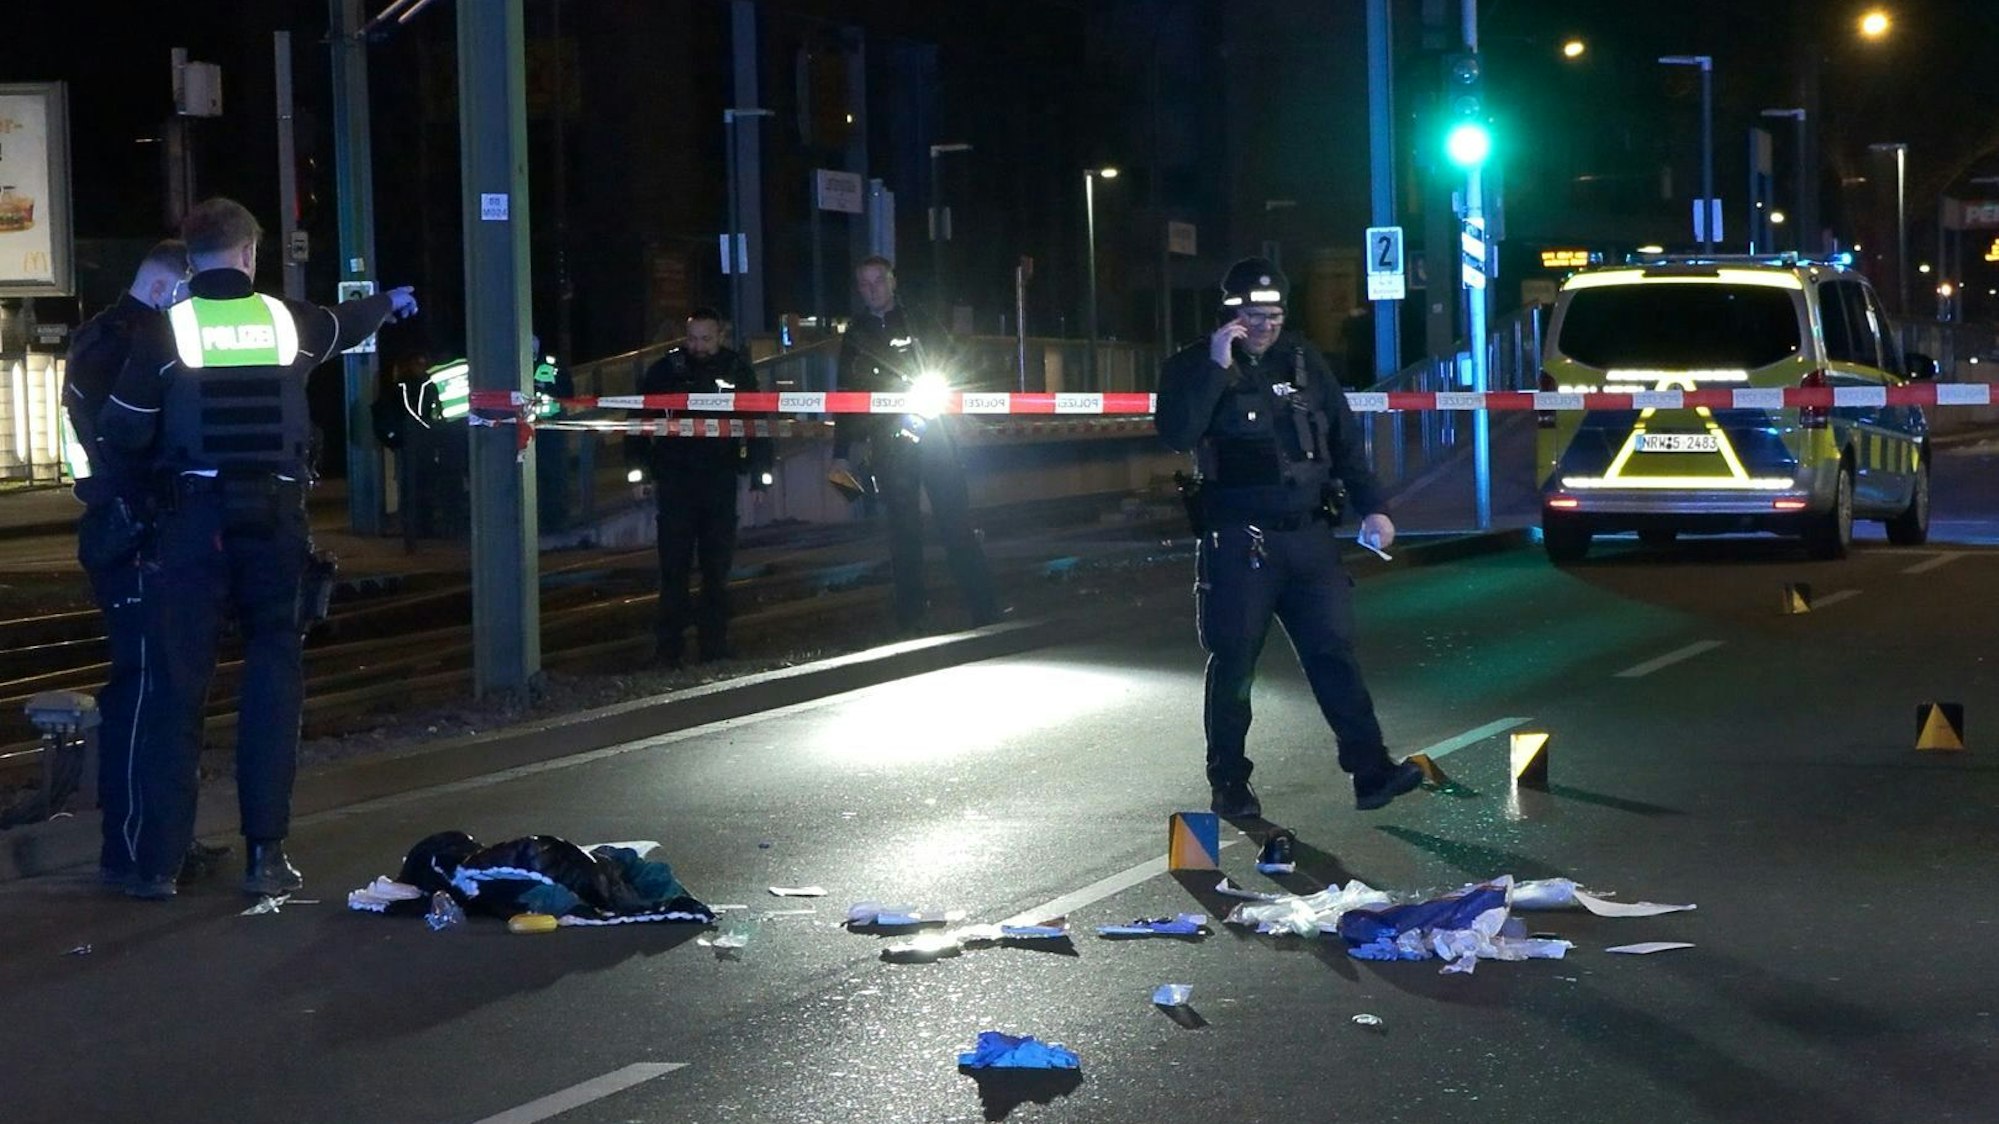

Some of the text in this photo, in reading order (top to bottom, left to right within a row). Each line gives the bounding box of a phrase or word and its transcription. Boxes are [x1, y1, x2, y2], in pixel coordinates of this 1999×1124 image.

[1378, 235, 1392, 267] 2
[202, 325, 275, 350] POLIZEI
[1643, 436, 1666, 449] NRW
